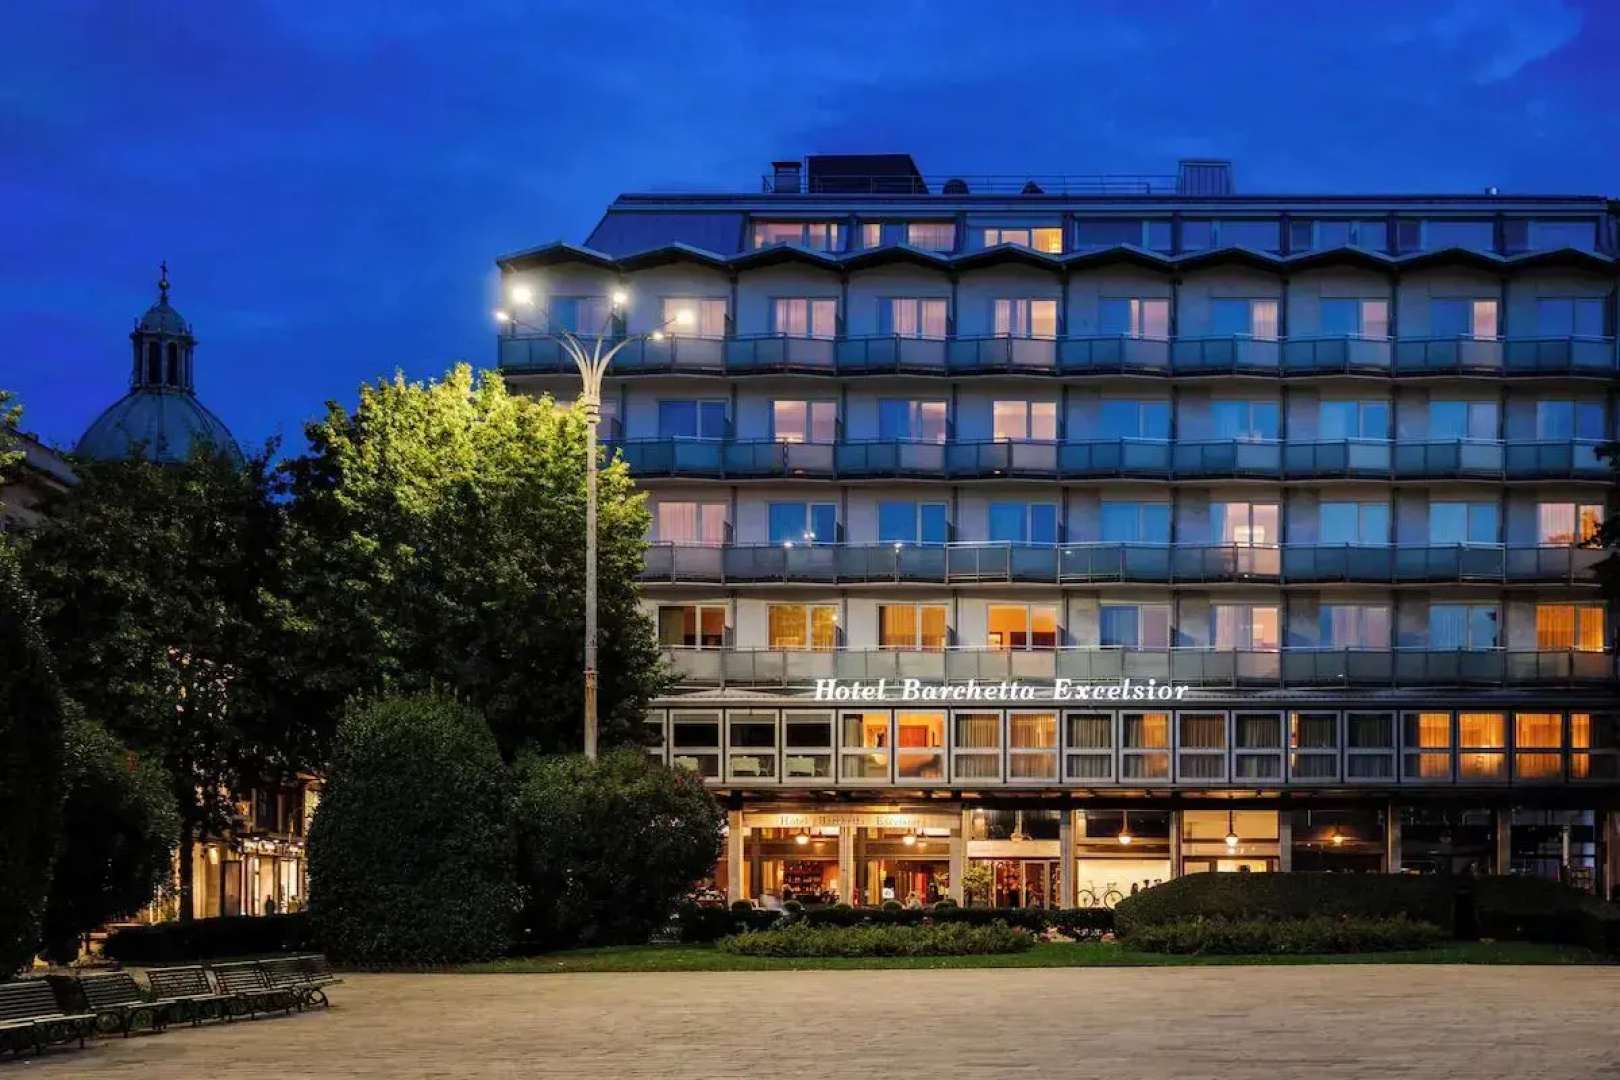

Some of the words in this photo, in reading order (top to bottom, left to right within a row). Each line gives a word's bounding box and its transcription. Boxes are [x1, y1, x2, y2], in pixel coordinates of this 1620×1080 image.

[814, 678, 887, 701] Hotel
[901, 678, 1036, 701] Barchetta
[1053, 678, 1190, 701] Excelsior
